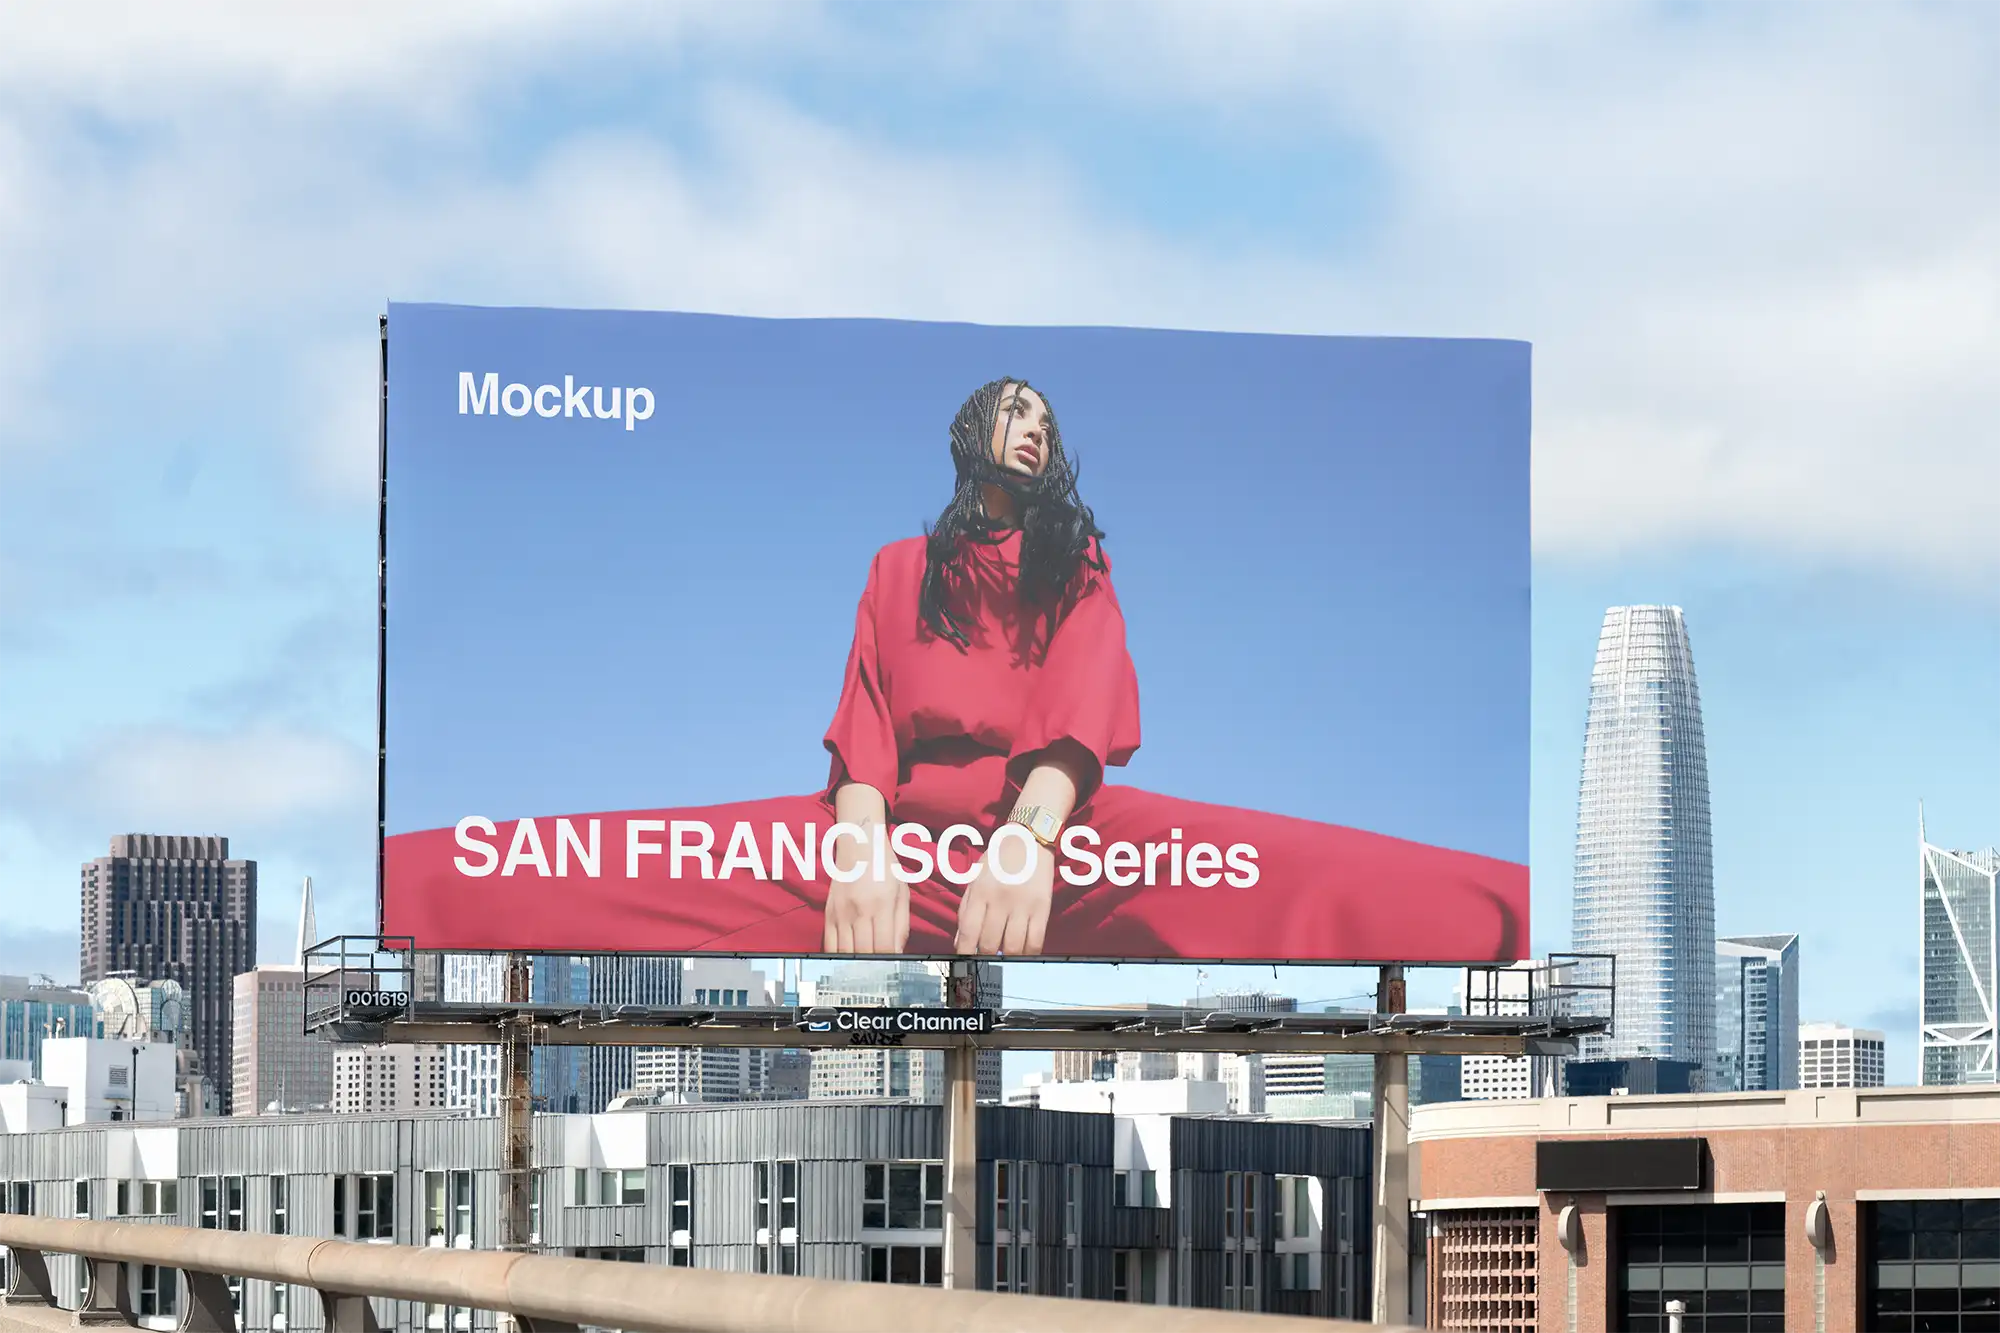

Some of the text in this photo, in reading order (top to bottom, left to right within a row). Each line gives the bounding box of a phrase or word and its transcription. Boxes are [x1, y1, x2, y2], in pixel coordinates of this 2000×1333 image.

[458, 371, 655, 431] Mockup
[453, 815, 1260, 889] SAN FRANCISCO Series
[349, 991, 408, 1007] 001619
[836, 1011, 984, 1031] Clear Channel
